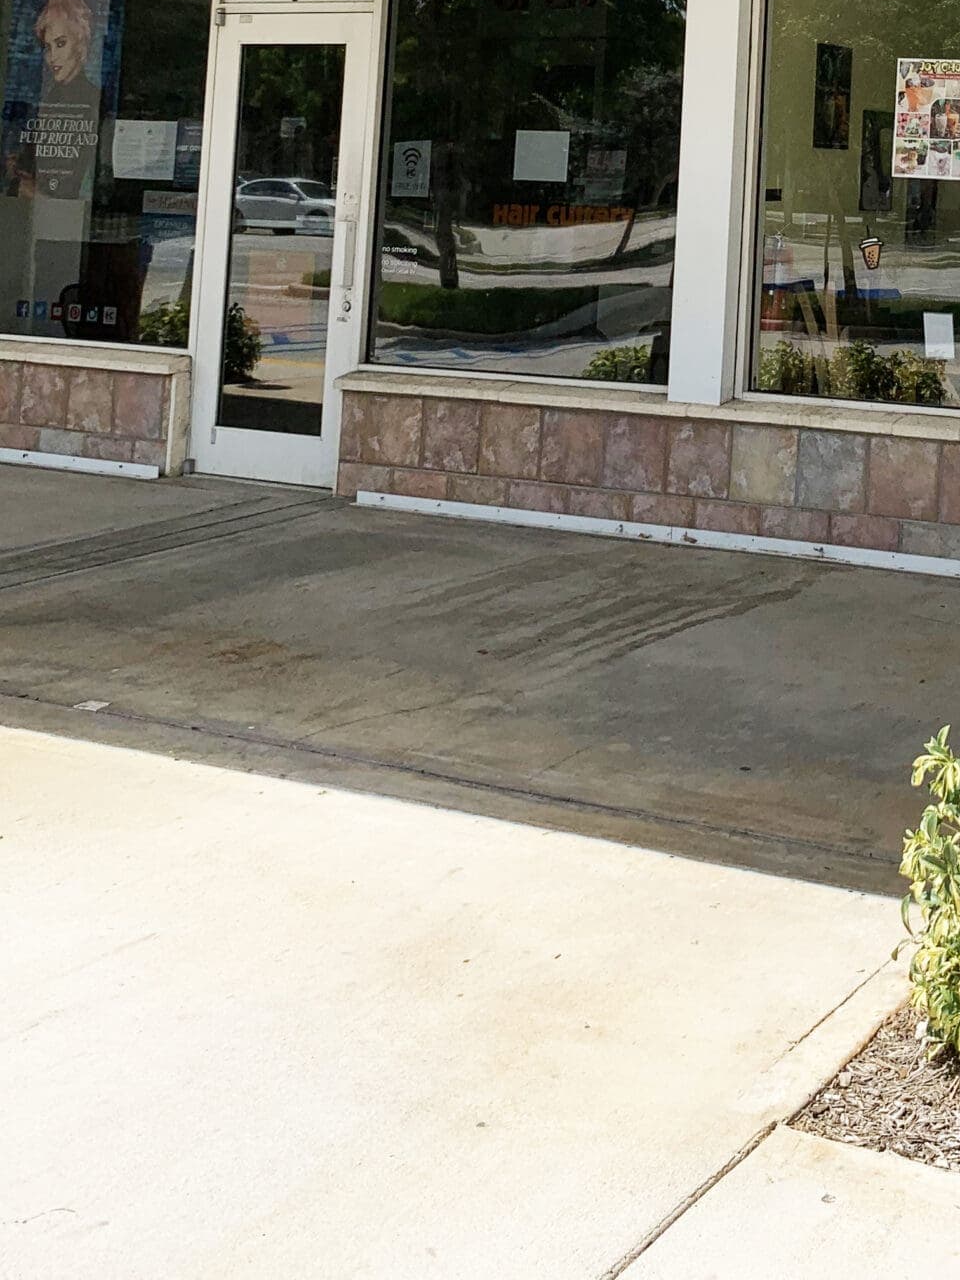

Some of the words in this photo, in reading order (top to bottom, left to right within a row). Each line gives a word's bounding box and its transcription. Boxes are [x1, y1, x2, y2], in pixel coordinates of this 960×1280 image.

[920, 61, 940, 74] JOY
[26, 118, 62, 131] COLOR
[62, 120, 95, 132] FROM
[19, 131, 47, 144] PULP
[47, 132, 73, 144] RIOT
[73, 133, 98, 145] AND
[35, 145, 80, 158] REDKEN
[391, 246, 418, 255] smoking
